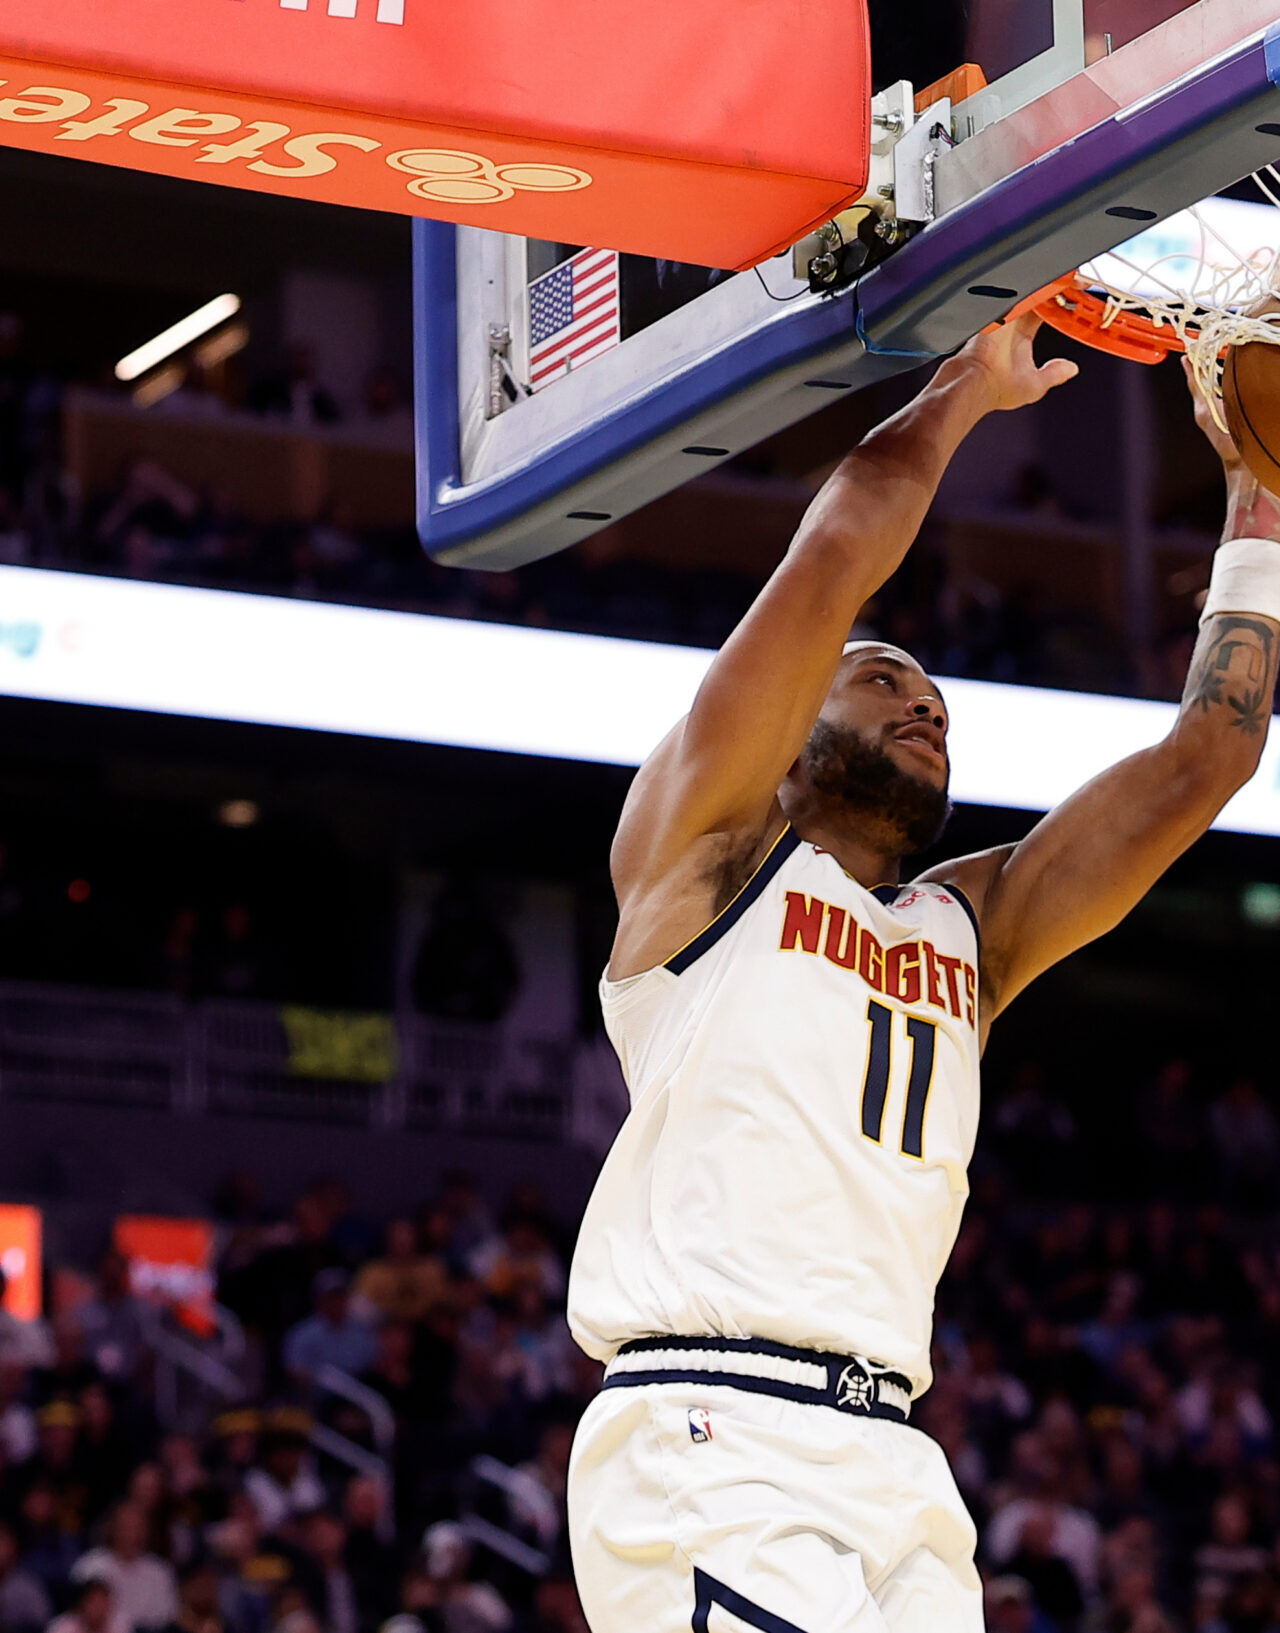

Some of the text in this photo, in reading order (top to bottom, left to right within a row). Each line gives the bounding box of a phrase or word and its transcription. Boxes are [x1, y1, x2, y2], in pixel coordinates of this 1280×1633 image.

[0, 86, 382, 178] State
[778, 889, 976, 1032] NUGGETS
[859, 995, 938, 1162] 11
